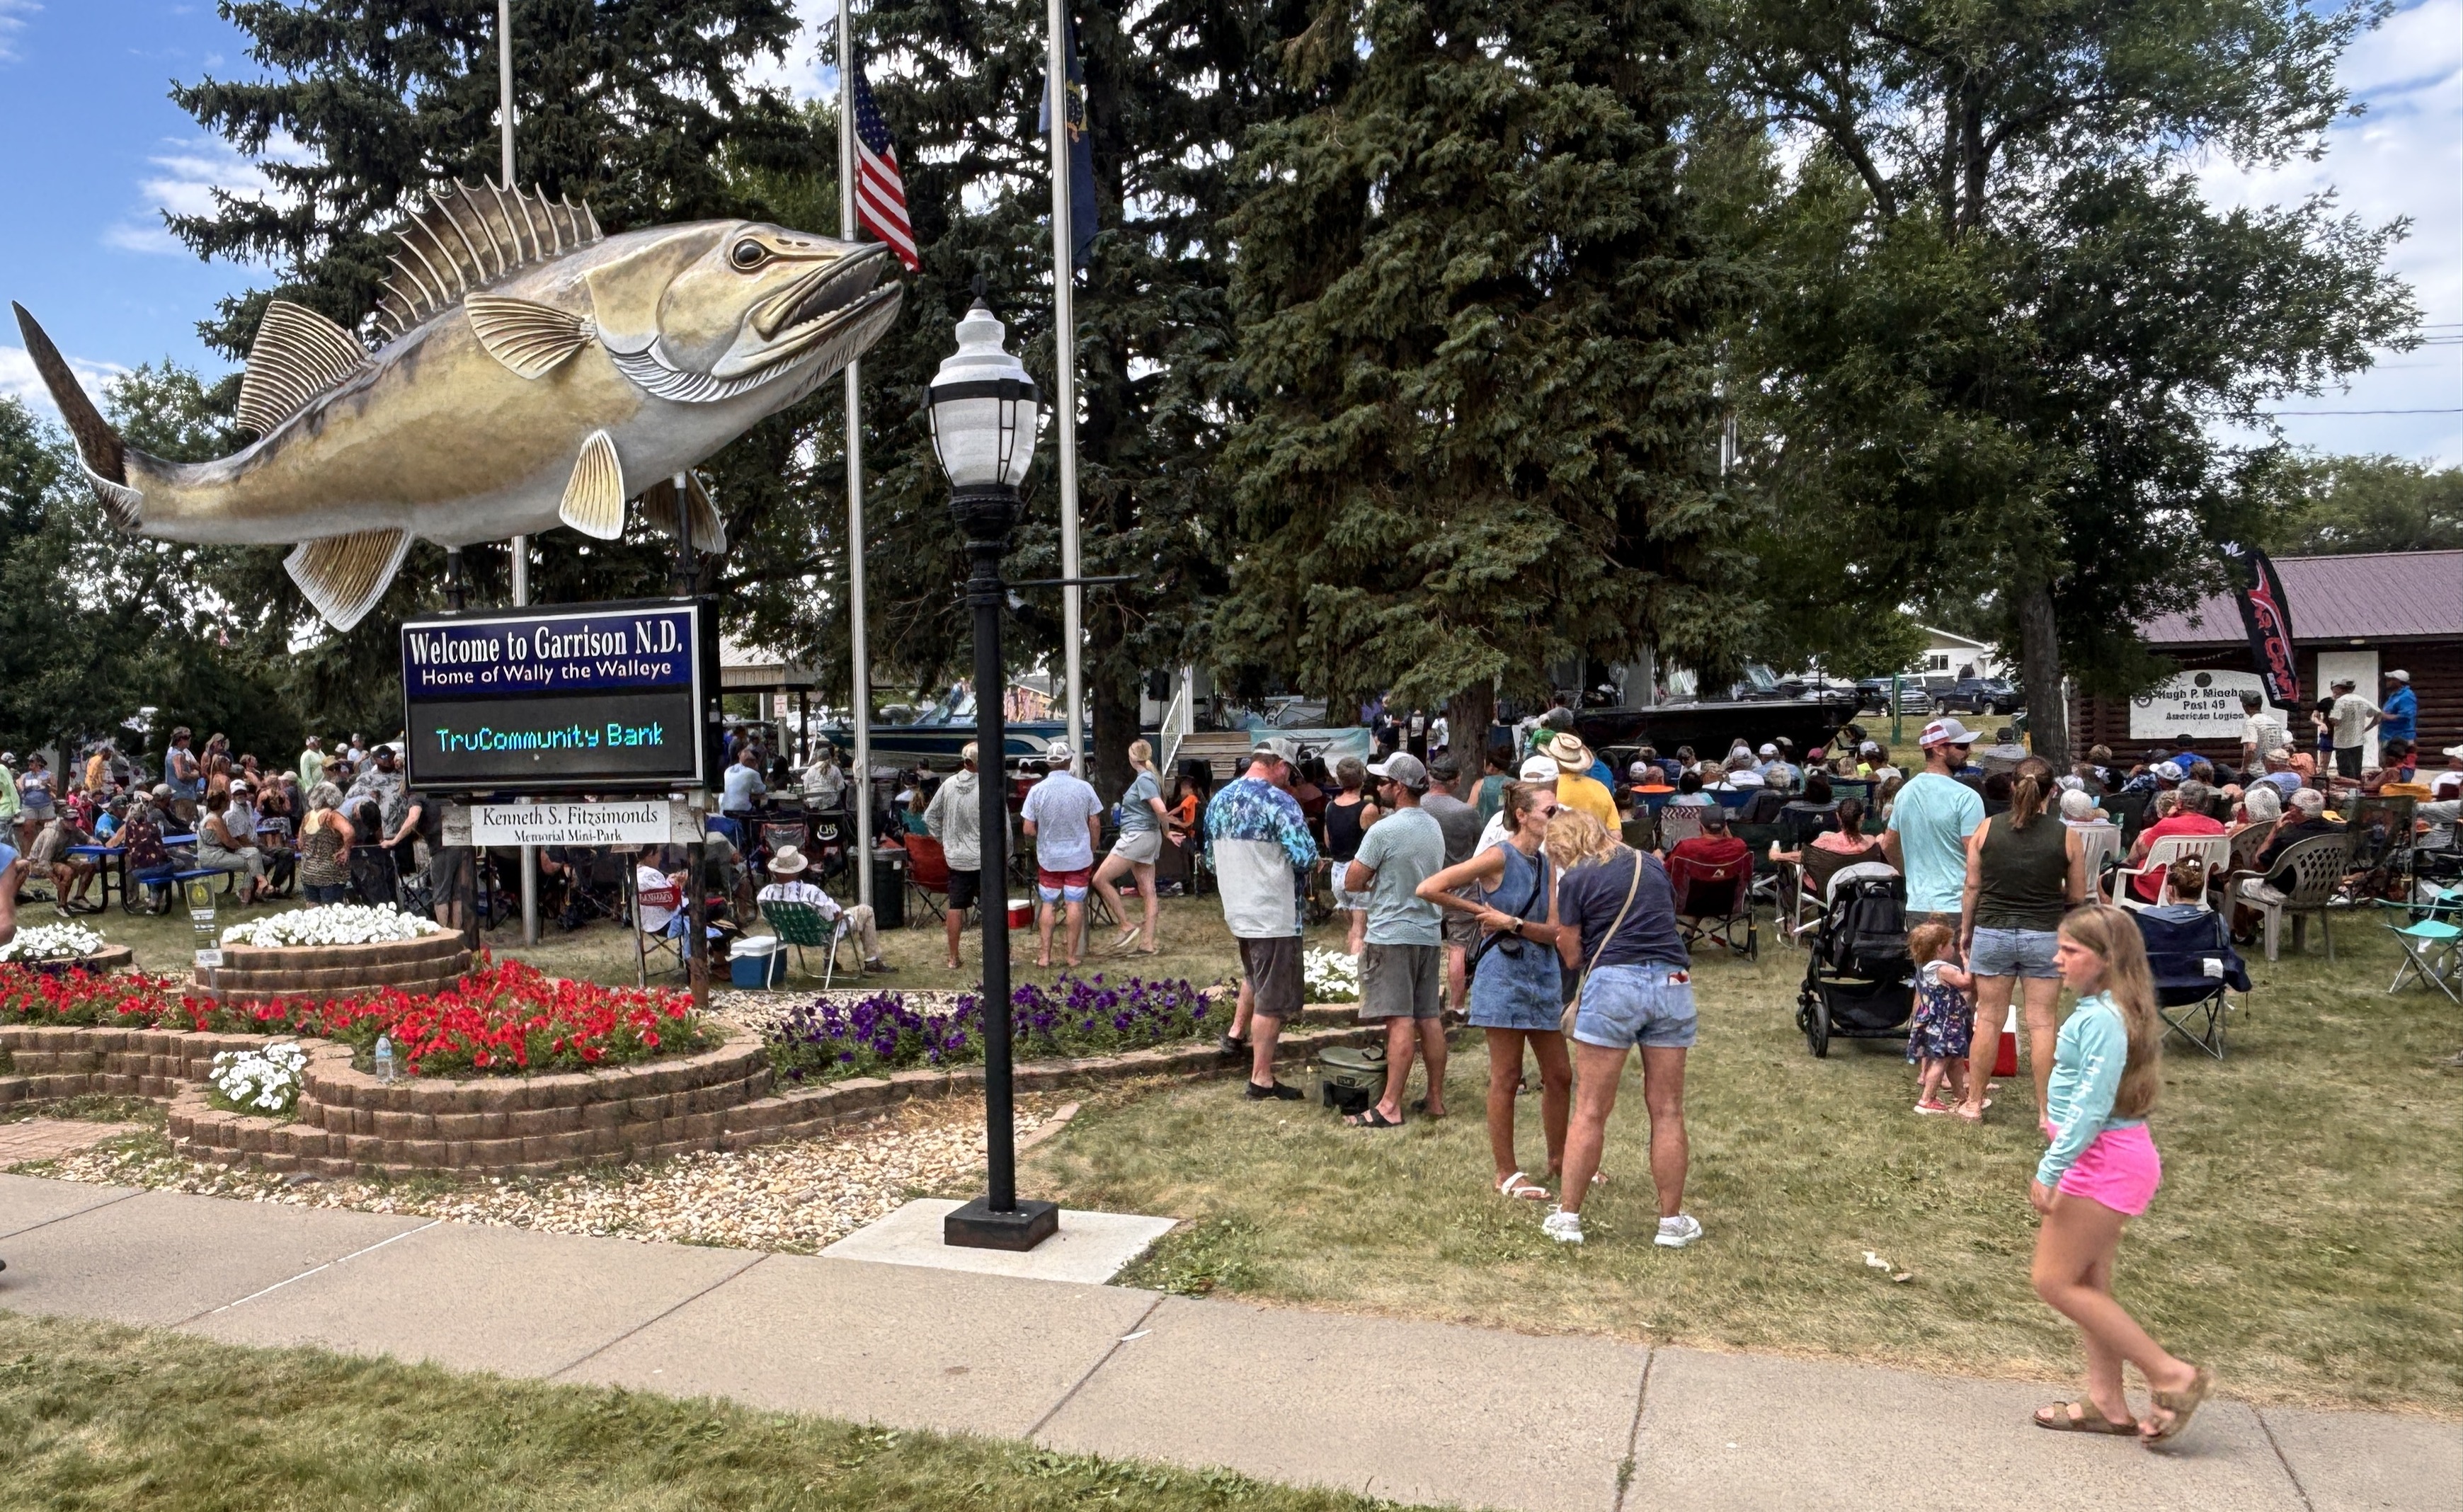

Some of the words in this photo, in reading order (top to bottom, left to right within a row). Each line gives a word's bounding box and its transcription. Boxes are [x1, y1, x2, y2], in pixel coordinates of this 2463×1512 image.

[409, 631, 500, 665] Welcome
[508, 631, 527, 661] to
[535, 624, 627, 660] Garrison
[635, 619, 682, 654] N.D.
[423, 669, 474, 685] Home
[481, 665, 499, 682] of
[503, 663, 554, 685] Wally
[561, 662, 590, 680] the
[595, 659, 671, 680] Walleye
[2157, 689, 2187, 701] Hugh
[2190, 689, 2199, 699] P.
[2183, 701, 2207, 711] Post
[2166, 711, 2210, 721] American
[2213, 711, 2244, 721] Legion
[435, 723, 600, 752] TruCommunity
[607, 721, 663, 746] Bank
[483, 806, 544, 826] Kenneth
[548, 806, 562, 825] S.
[568, 803, 658, 827] Fitzsimonds
[514, 830, 565, 842] Memorial
[568, 828, 623, 842] Mini-Park
